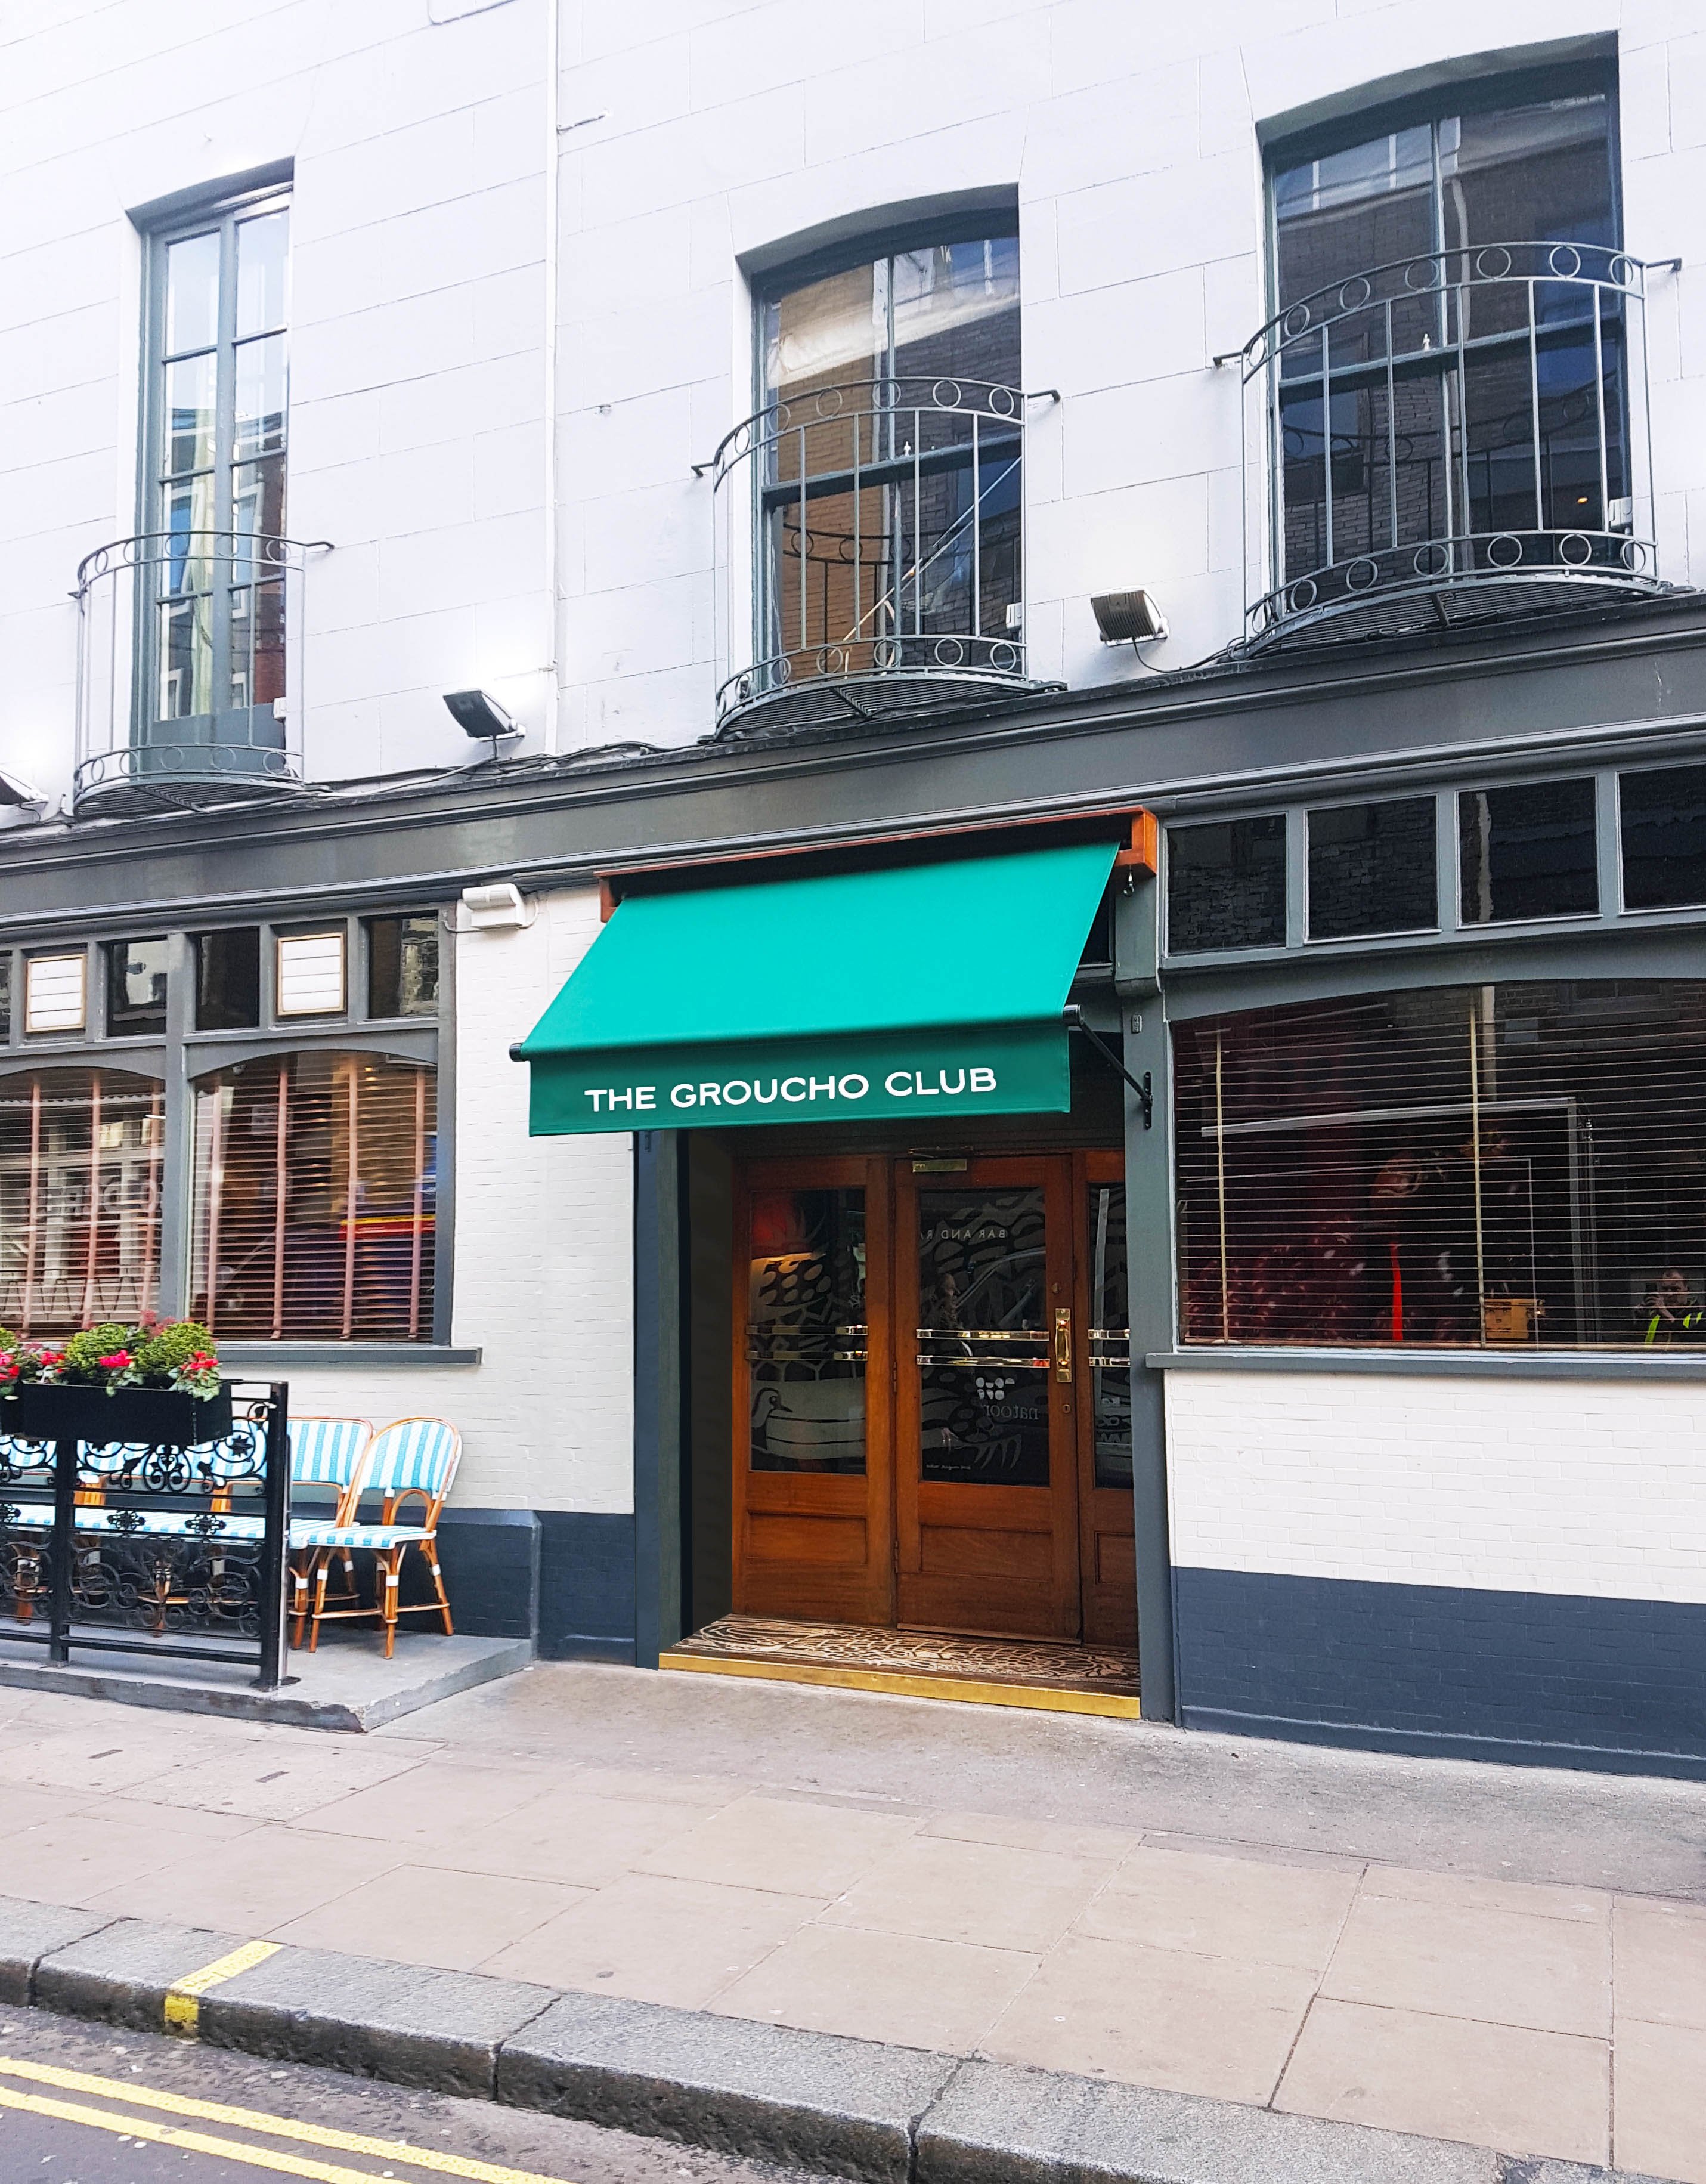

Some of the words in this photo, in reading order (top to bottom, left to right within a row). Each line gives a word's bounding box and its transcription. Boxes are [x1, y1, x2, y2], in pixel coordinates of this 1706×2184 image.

[584, 1085, 657, 1112] THE
[670, 1074, 869, 1108] GROUCHO
[885, 1067, 998, 1097] CLUB
